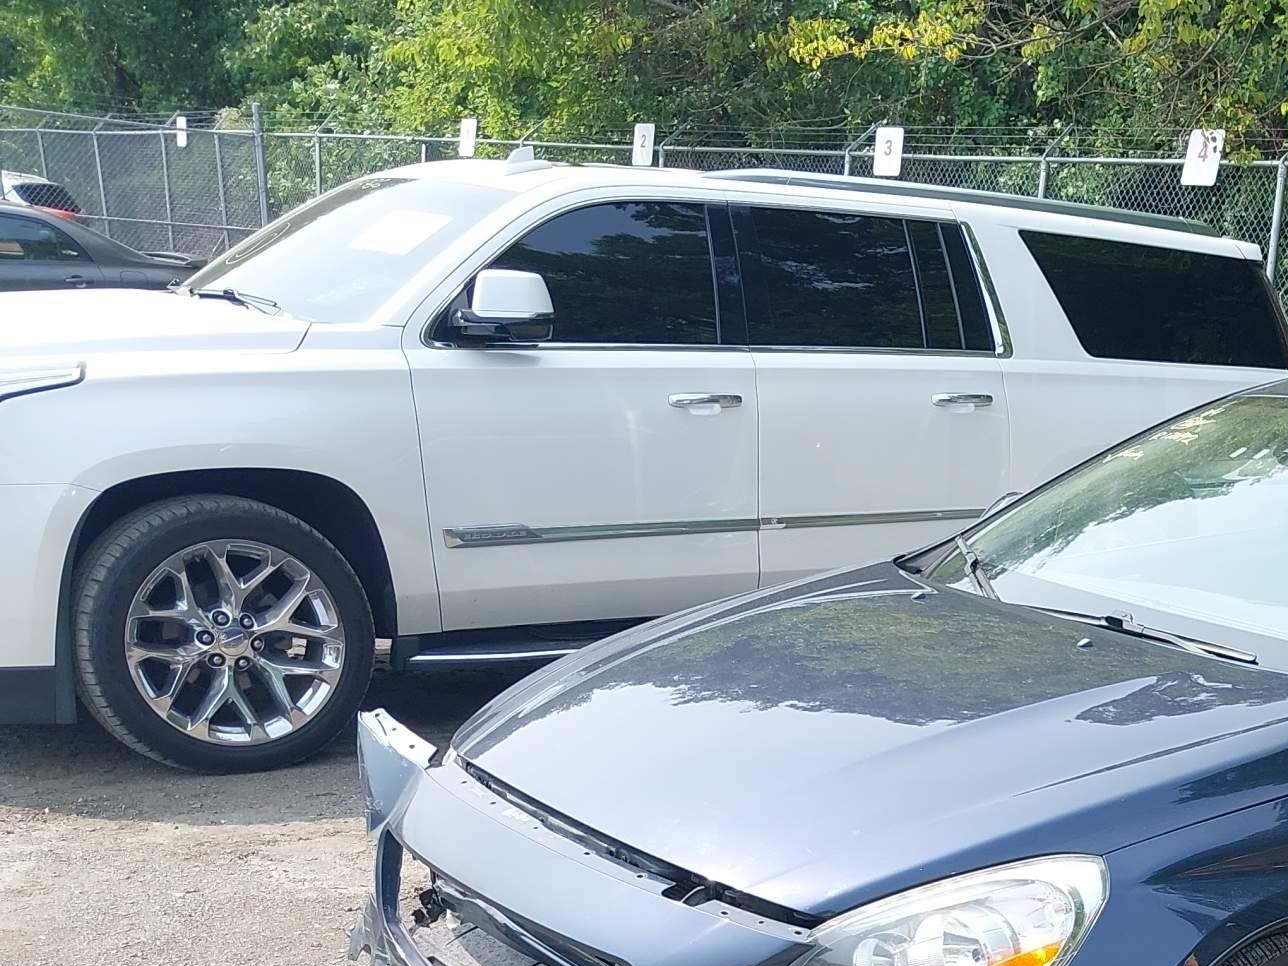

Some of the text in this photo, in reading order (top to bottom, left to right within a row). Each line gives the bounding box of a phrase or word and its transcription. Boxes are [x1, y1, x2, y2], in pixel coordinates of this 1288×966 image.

[640, 134, 647, 148] 2
[884, 140, 893, 156] 3
[1198, 140, 1208, 162] 4
